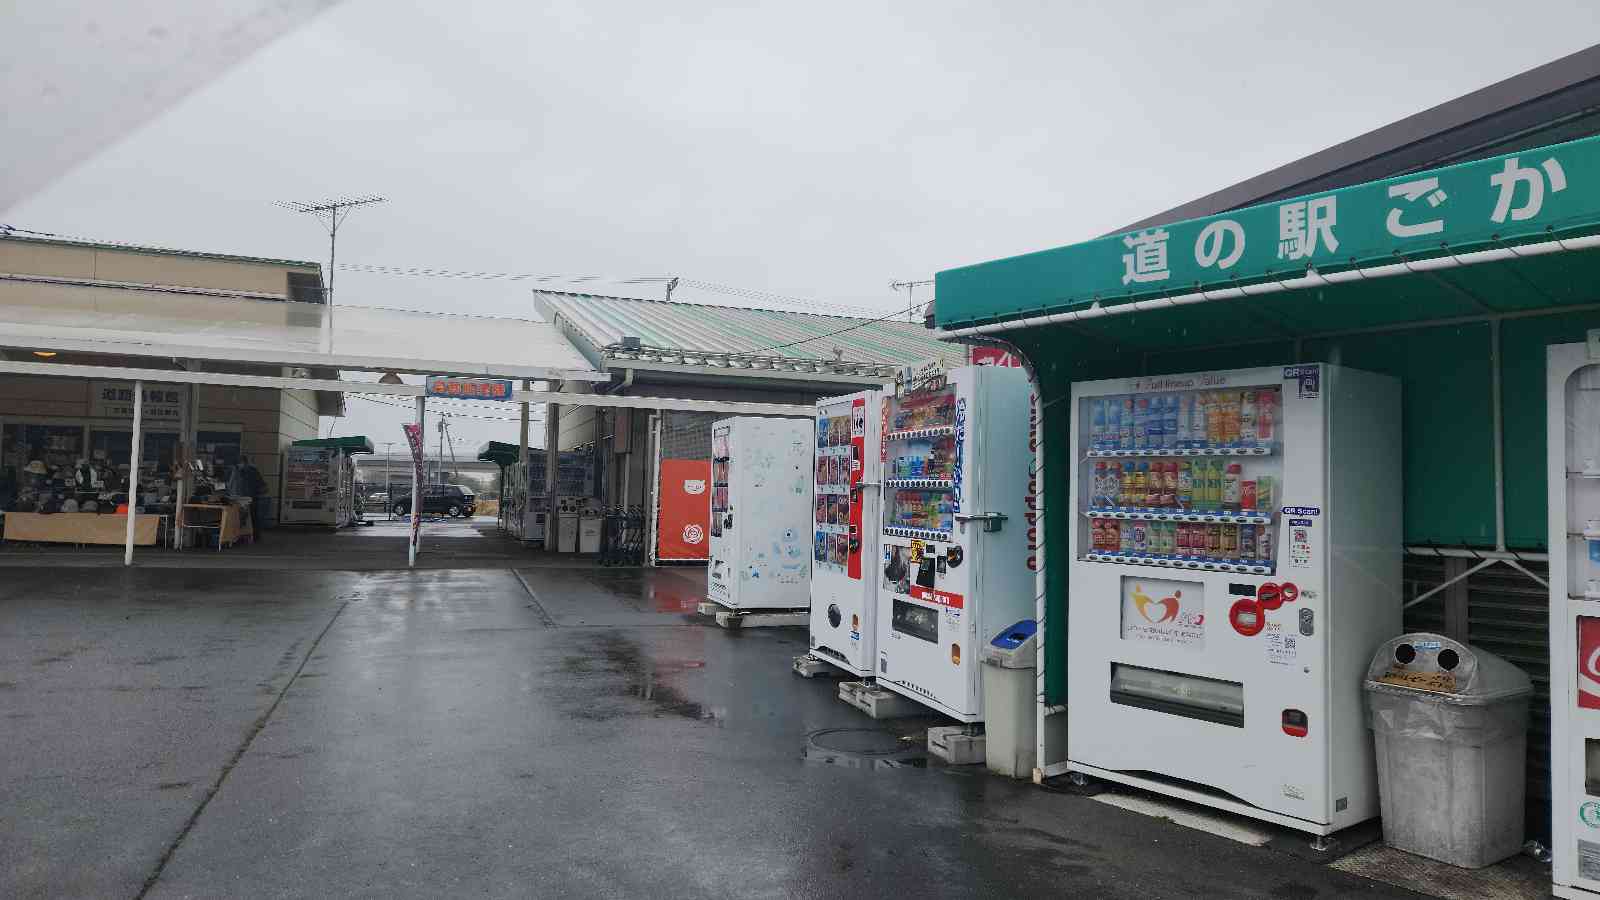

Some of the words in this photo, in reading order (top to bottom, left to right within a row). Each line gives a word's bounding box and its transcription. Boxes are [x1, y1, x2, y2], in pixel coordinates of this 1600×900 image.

[1121, 156, 1568, 286] 道の駅ごか
